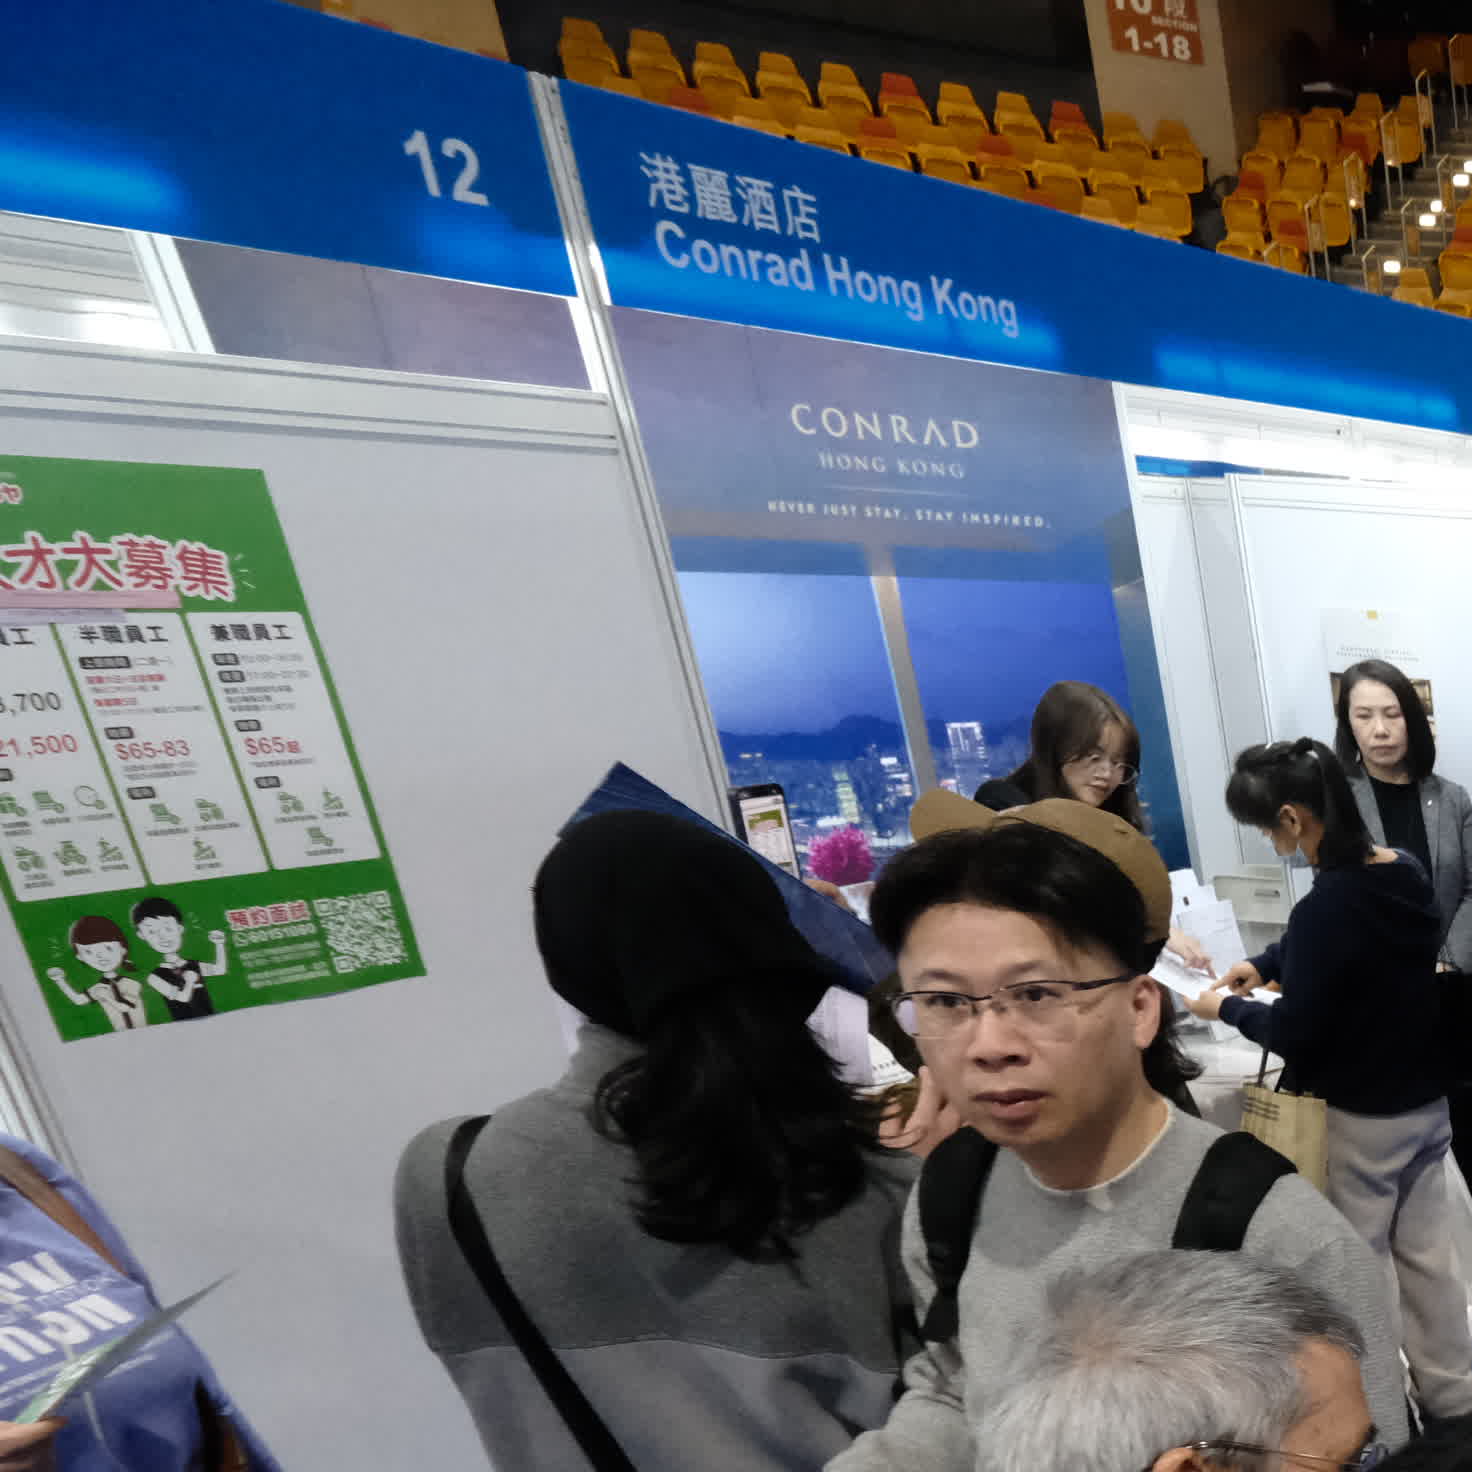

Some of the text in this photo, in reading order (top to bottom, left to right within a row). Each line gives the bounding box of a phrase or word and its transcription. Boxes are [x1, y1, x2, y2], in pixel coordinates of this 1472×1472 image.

[1124, 26, 1192, 61] 1-18
[403, 129, 490, 207] 12
[640, 151, 821, 244] 港麗酒店
[655, 219, 1019, 338] Conrad Hong Kong
[791, 402, 980, 450] CONRAD
[818, 451, 966, 481] HONG KONG
[767, 501, 817, 515] NEVER
[823, 504, 857, 518] JUST
[915, 509, 953, 522] STAY
[0, 533, 234, 600] 才大募集
[114, 739, 191, 760] $65-83
